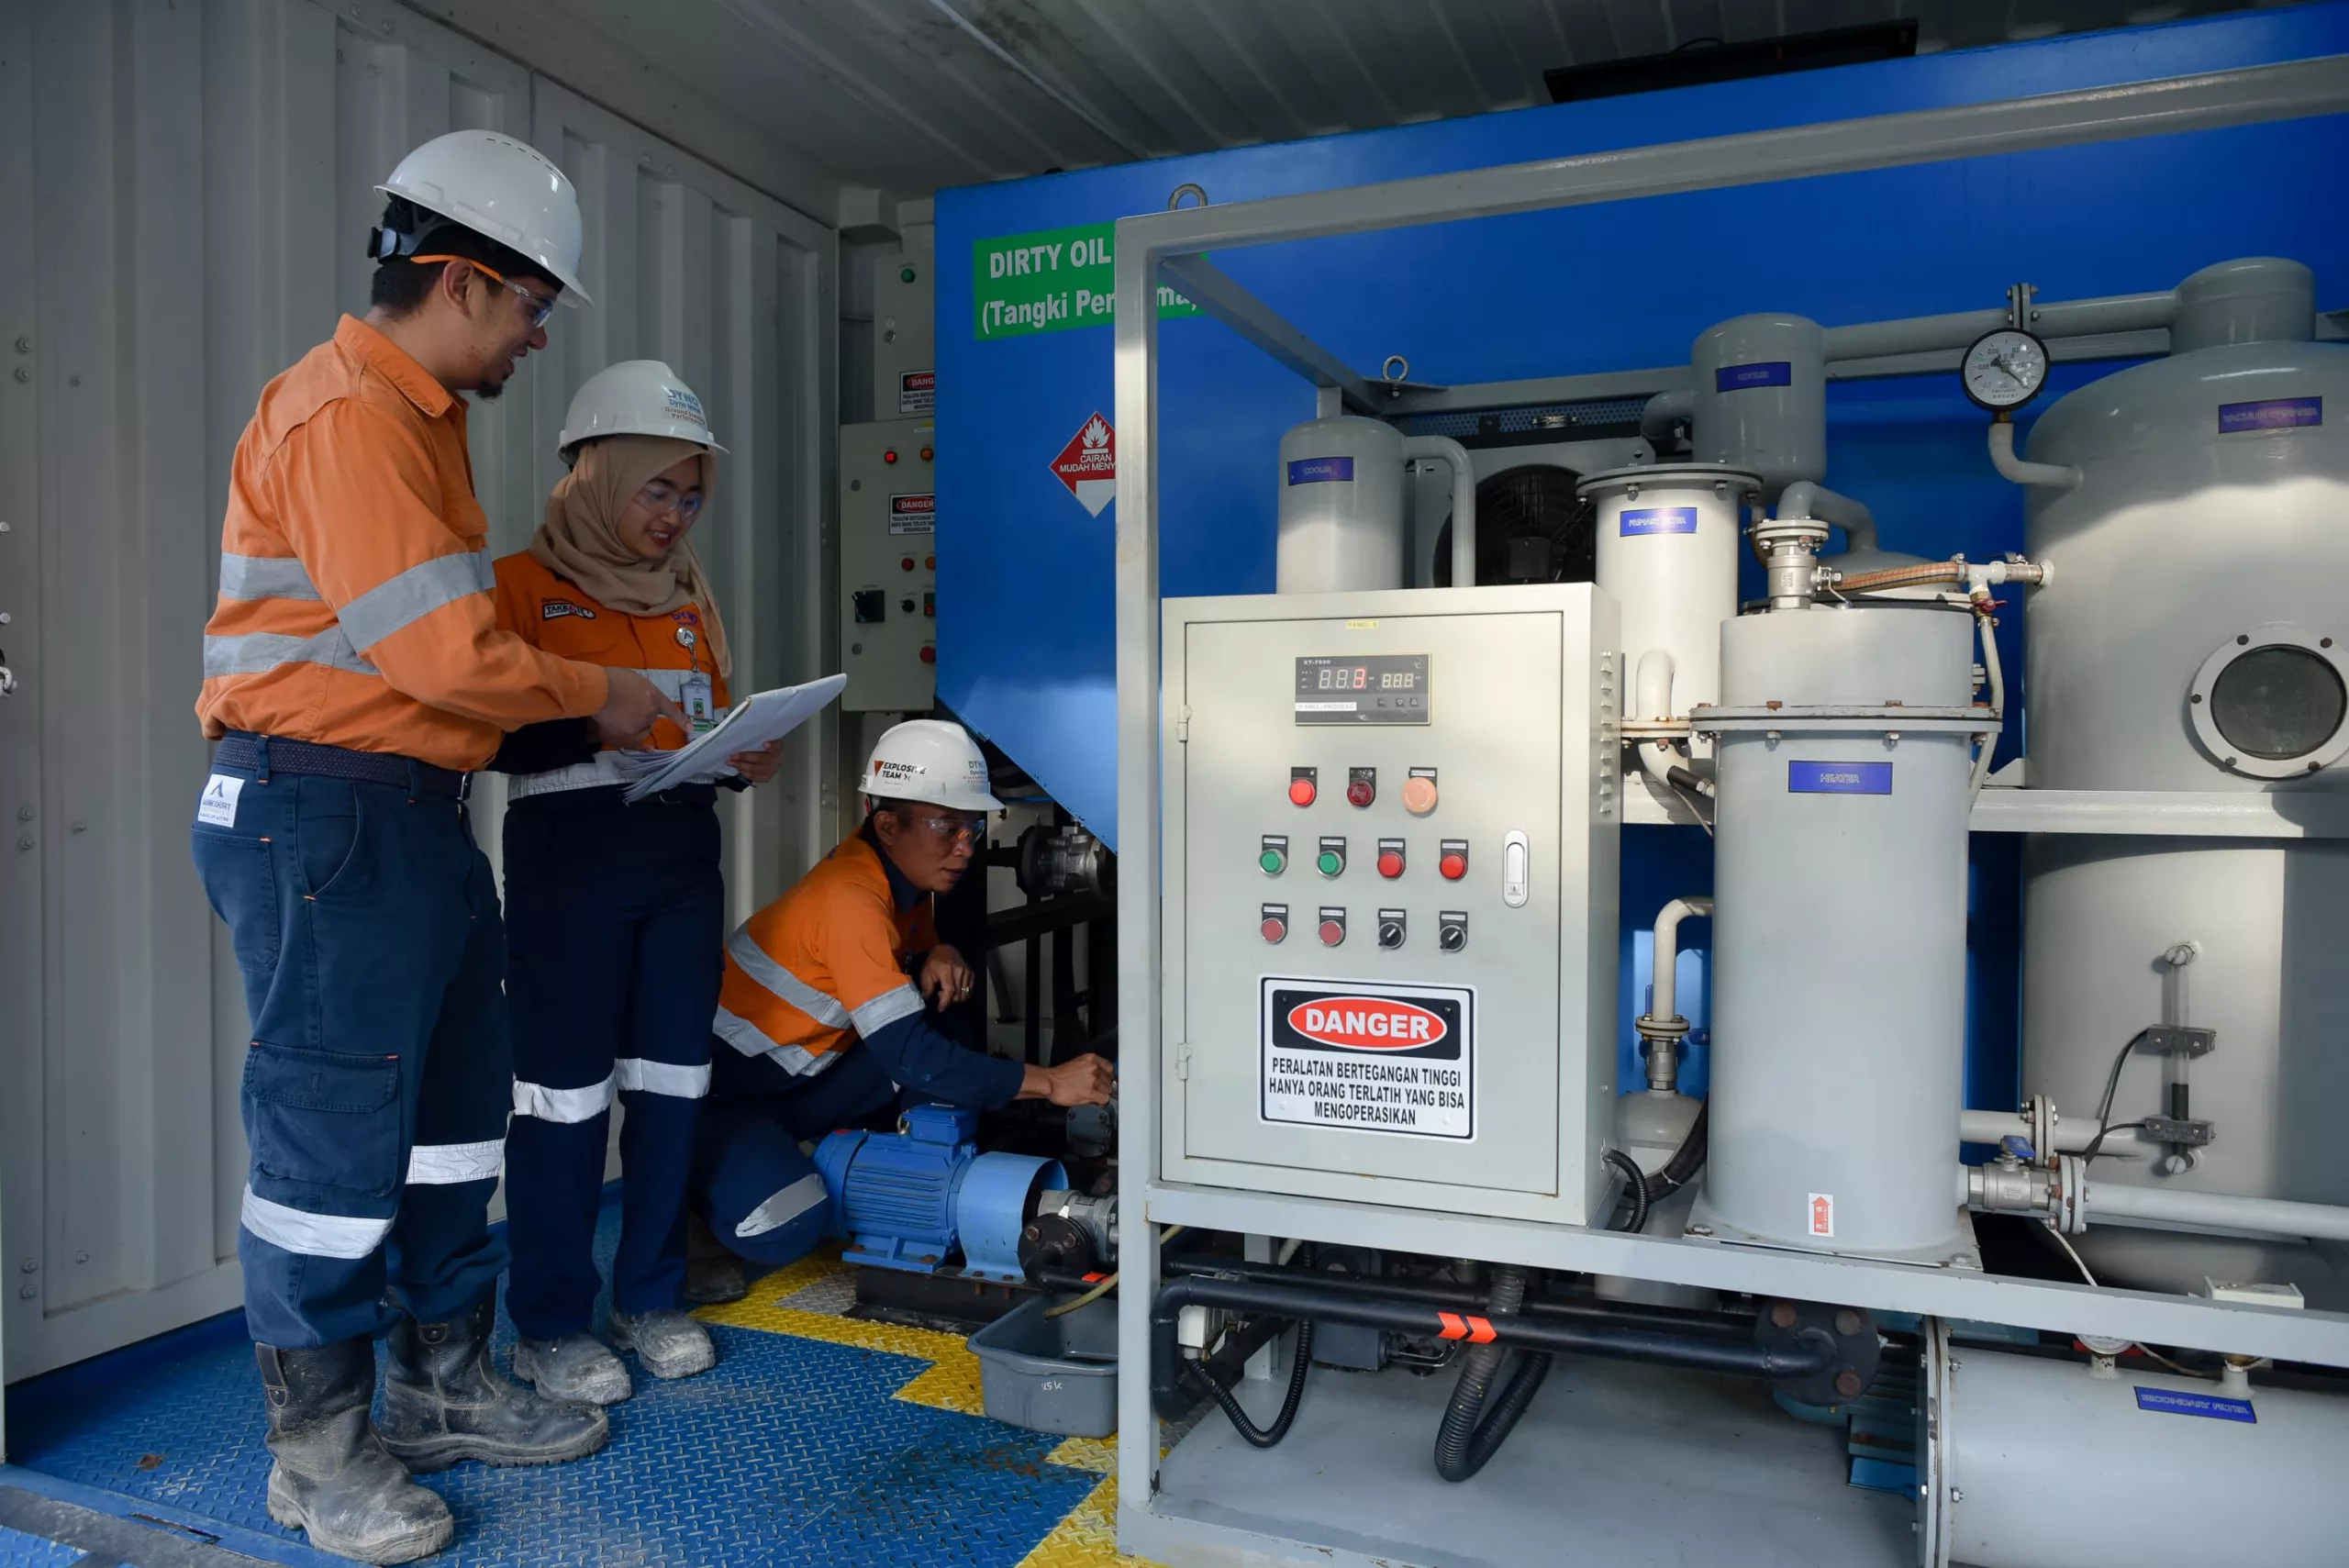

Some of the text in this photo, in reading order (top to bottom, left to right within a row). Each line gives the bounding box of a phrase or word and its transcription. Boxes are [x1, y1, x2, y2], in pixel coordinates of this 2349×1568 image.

[990, 239, 1112, 278] DIRTY OIL
[982, 292, 1068, 334] (Tangki
[1060, 464, 1090, 473] MUDAH
[1080, 453, 1111, 463] CAIRAN
[901, 500, 934, 509] DANGER
[547, 605, 568, 613] TAKE
[882, 770, 901, 780] TEAM
[1306, 1008, 1431, 1040] DANGER
[1273, 1057, 1461, 1087] PERALATAN BERTEGANGAN TINGGI
[1269, 1077, 1464, 1109] HANYA ORANG TERLATIH YANG BISA
[1314, 1101, 1416, 1126] MENGOPERASIKAN
